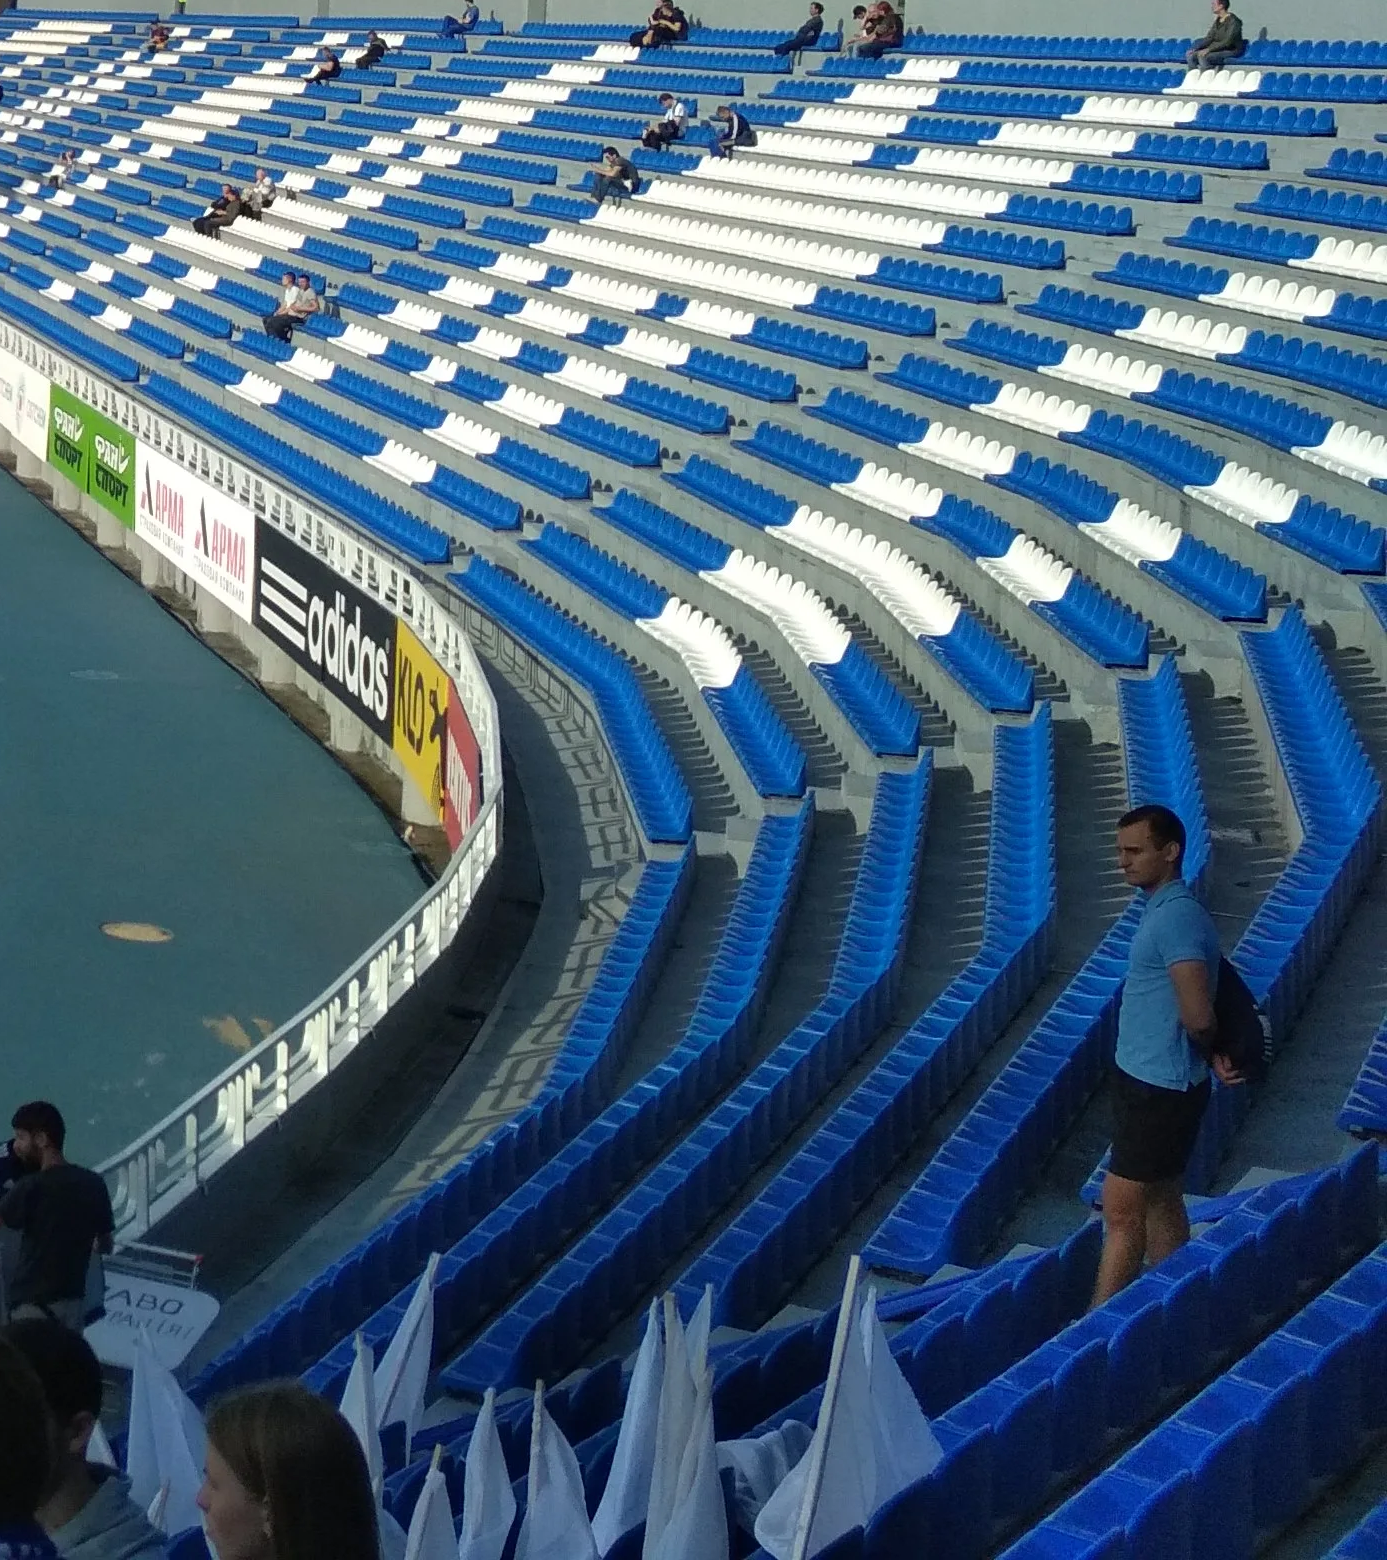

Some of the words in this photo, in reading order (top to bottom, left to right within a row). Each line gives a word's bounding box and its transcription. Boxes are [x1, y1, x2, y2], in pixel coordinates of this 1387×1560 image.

[54, 433, 83, 473] СПОРТ
[95, 462, 129, 508] СПОРТ
[307, 591, 389, 722] adidas
[396, 647, 427, 757] KLO
